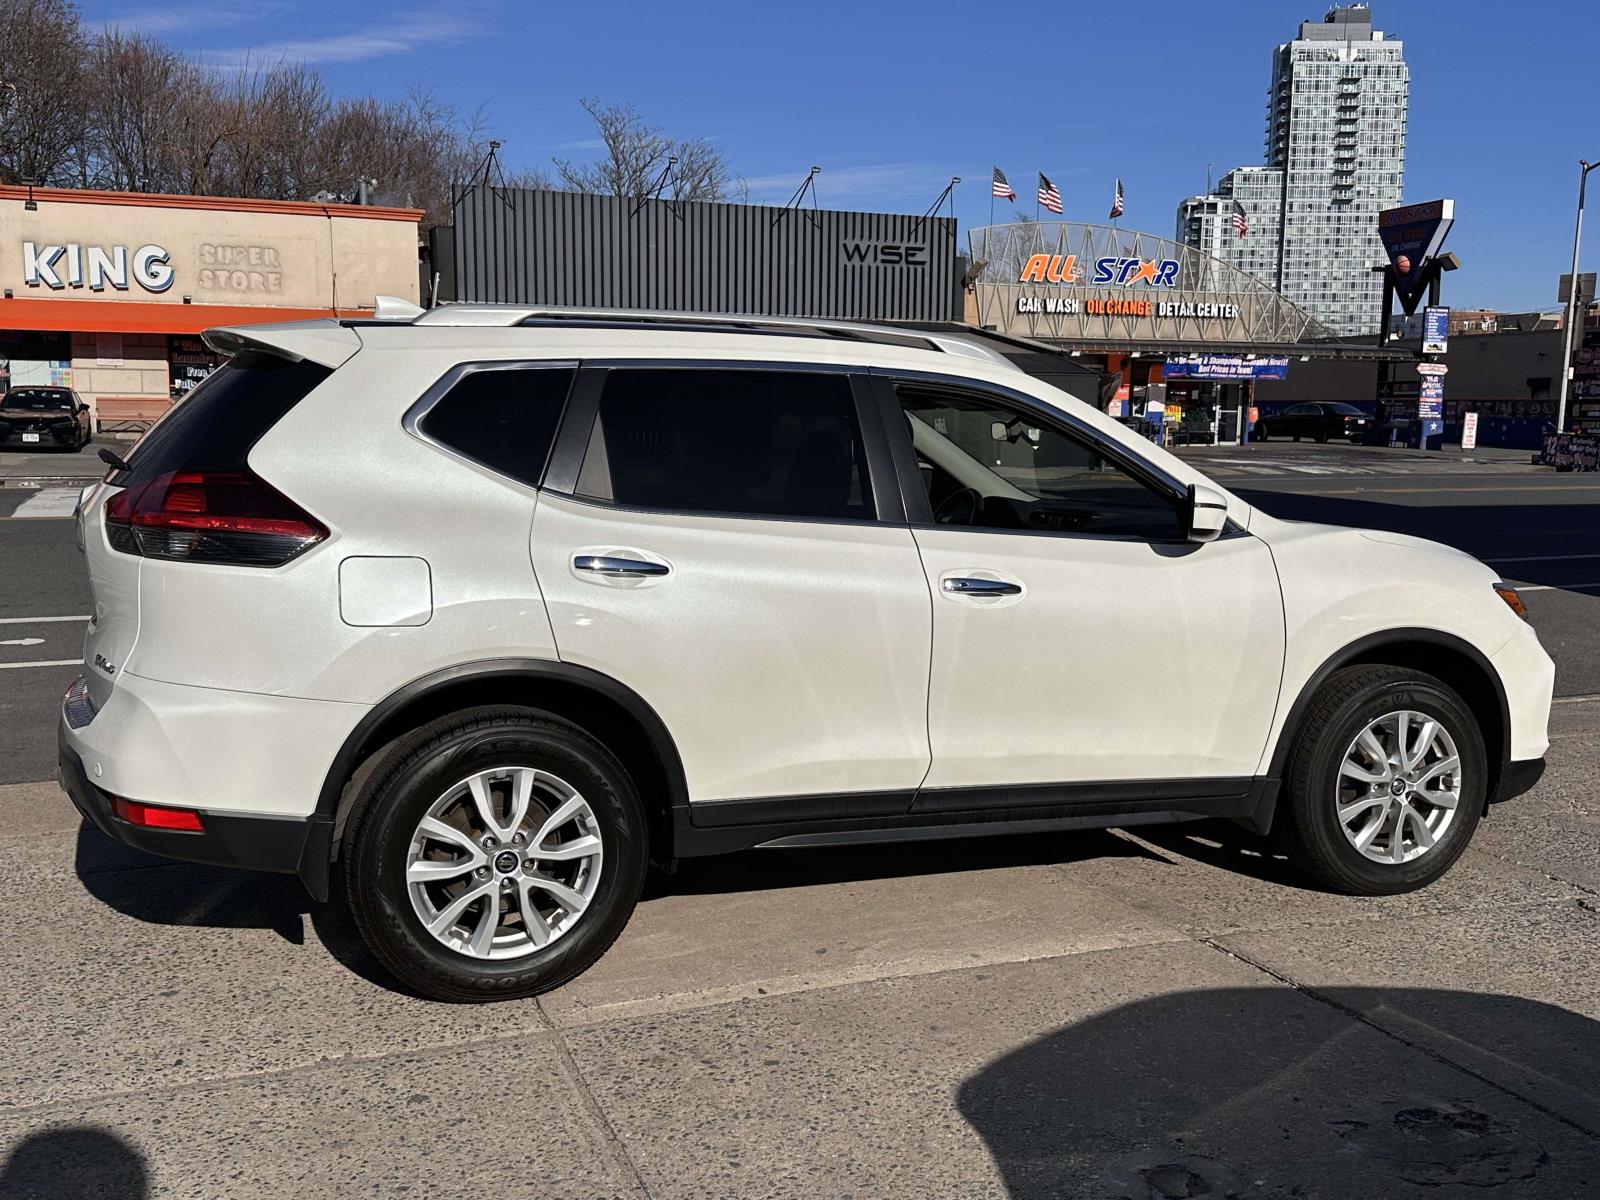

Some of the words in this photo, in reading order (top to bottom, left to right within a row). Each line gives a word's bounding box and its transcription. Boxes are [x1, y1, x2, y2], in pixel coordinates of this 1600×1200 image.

[199, 243, 282, 267] SUPER
[843, 243, 927, 265] WISE
[22, 241, 175, 293] KING
[1019, 254, 1077, 283] ALL
[1091, 256, 1180, 287] STAR
[199, 268, 282, 291] STORE
[1018, 297, 1042, 313] CAR
[1045, 298, 1079, 314] WASH
[1086, 300, 1105, 315] OIL
[1106, 300, 1152, 317] CHANGE
[1158, 302, 1195, 317] DETAIL
[1197, 303, 1239, 318] CENTER
[1198, 365, 1210, 373] Best
[1211, 365, 1229, 374] Prices
[1236, 366, 1253, 375] Town!
